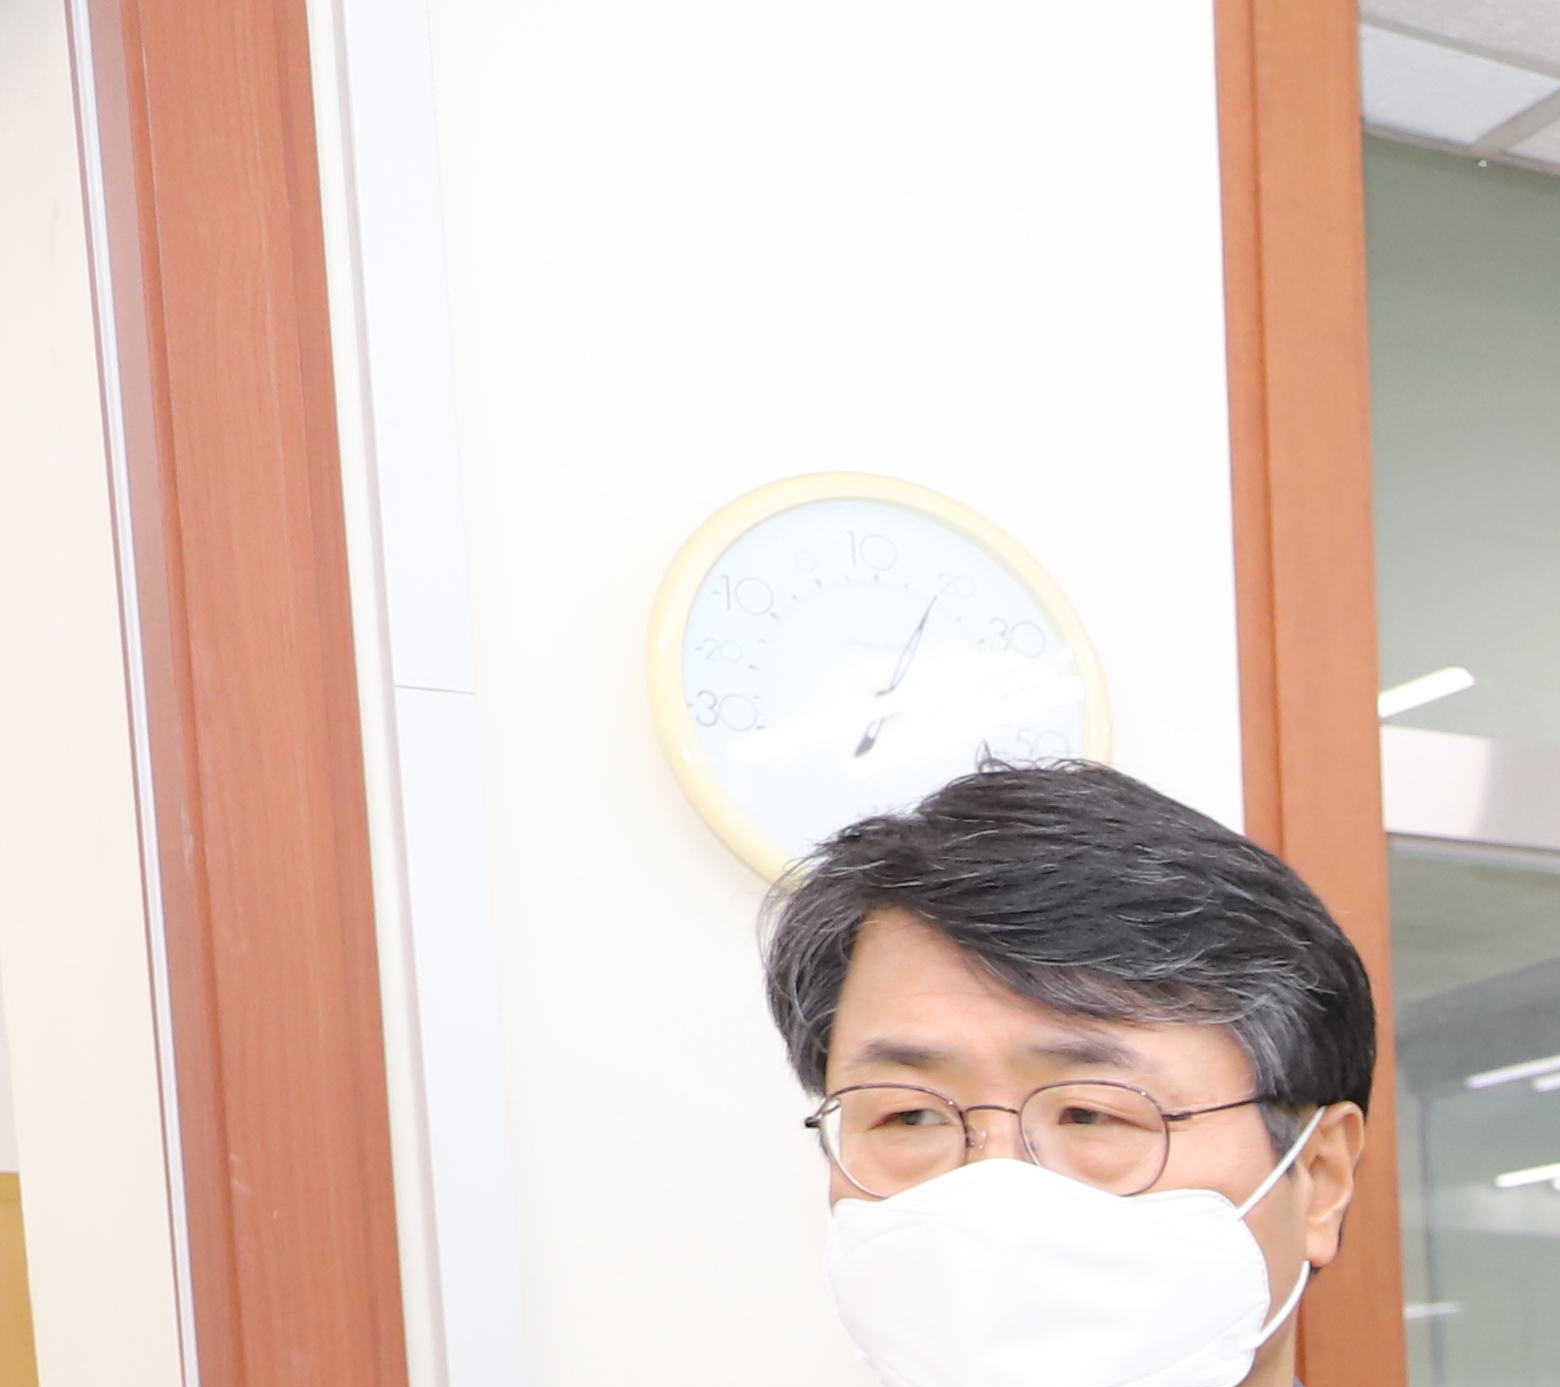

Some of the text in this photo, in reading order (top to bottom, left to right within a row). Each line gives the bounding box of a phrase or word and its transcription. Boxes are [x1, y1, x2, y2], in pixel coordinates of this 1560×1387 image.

[847, 531, 898, 572] 10
[937, 573, 976, 599] 20
[988, 617, 1047, 658] 30
